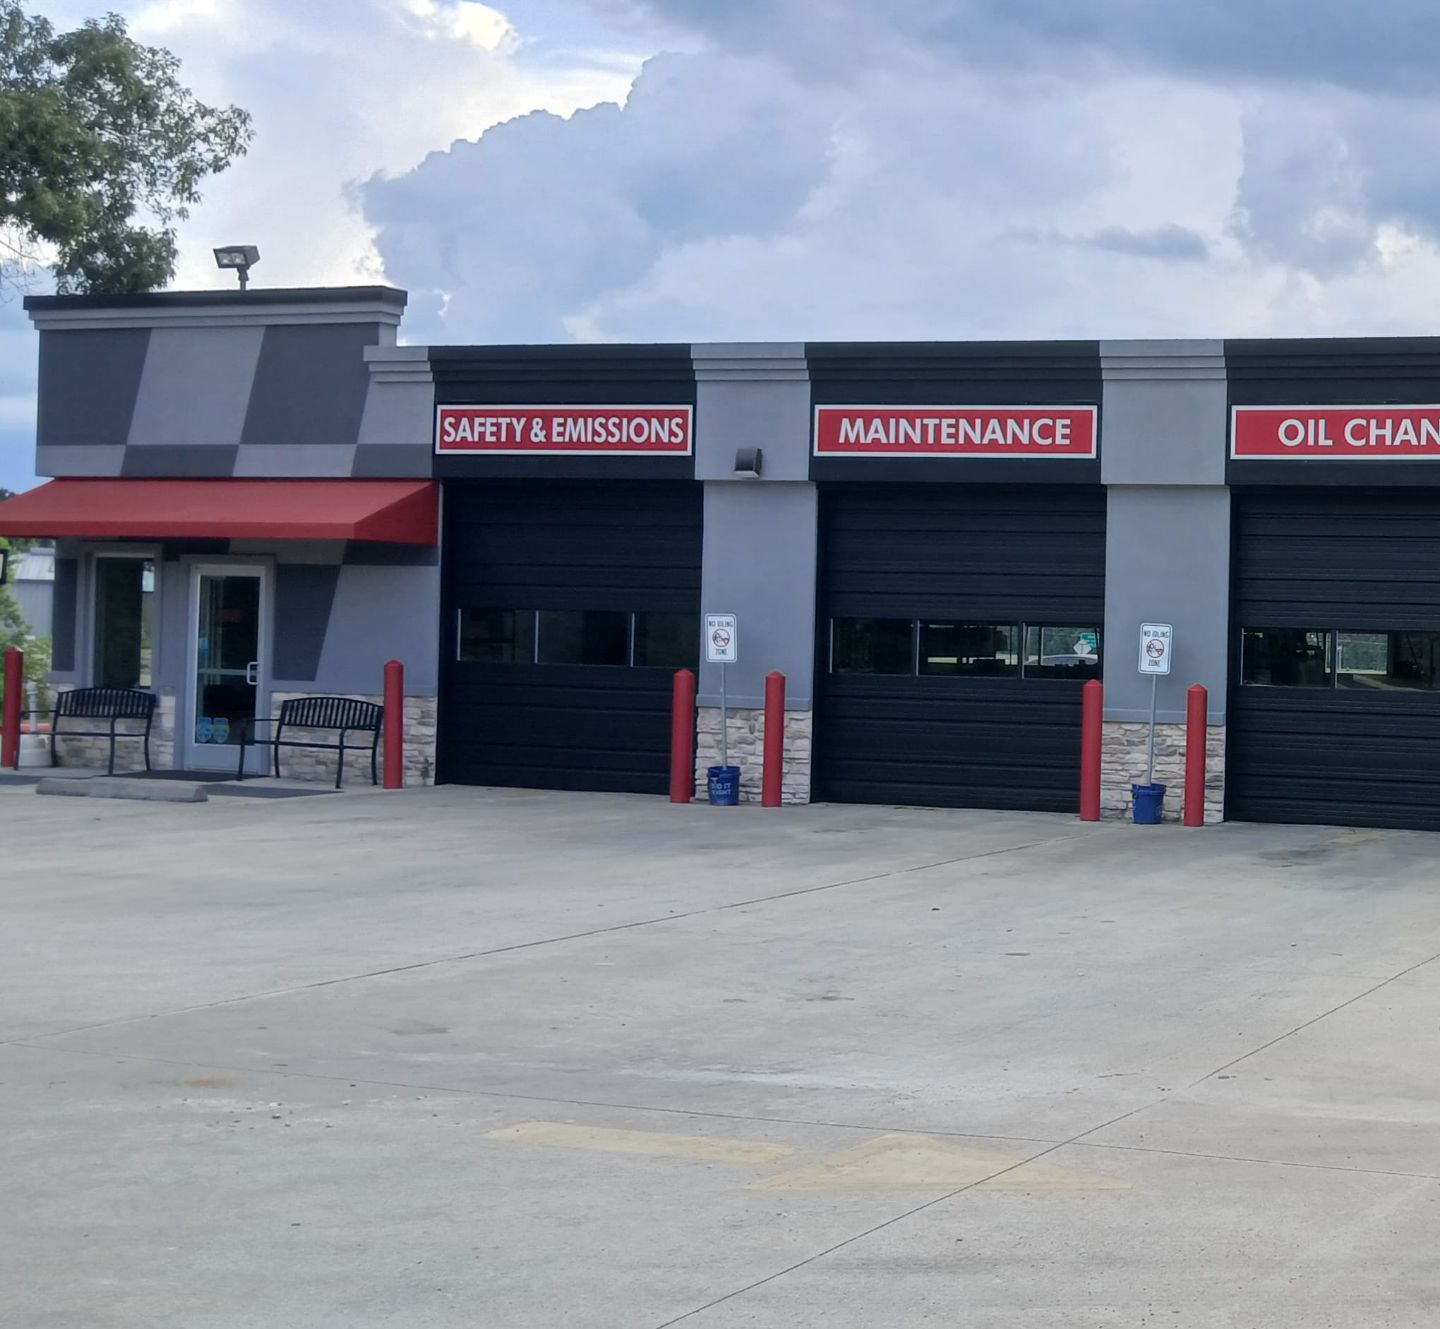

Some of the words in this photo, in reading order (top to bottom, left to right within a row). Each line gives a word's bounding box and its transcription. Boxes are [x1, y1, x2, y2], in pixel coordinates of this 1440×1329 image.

[443, 417, 526, 443] SAFETY
[530, 417, 547, 443] &
[552, 416, 684, 443] EMISSIONS
[838, 417, 1071, 445] MAINTENANCE
[1278, 418, 1333, 447] OIL
[708, 620, 716, 628] NO
[1143, 630, 1151, 638] NO
